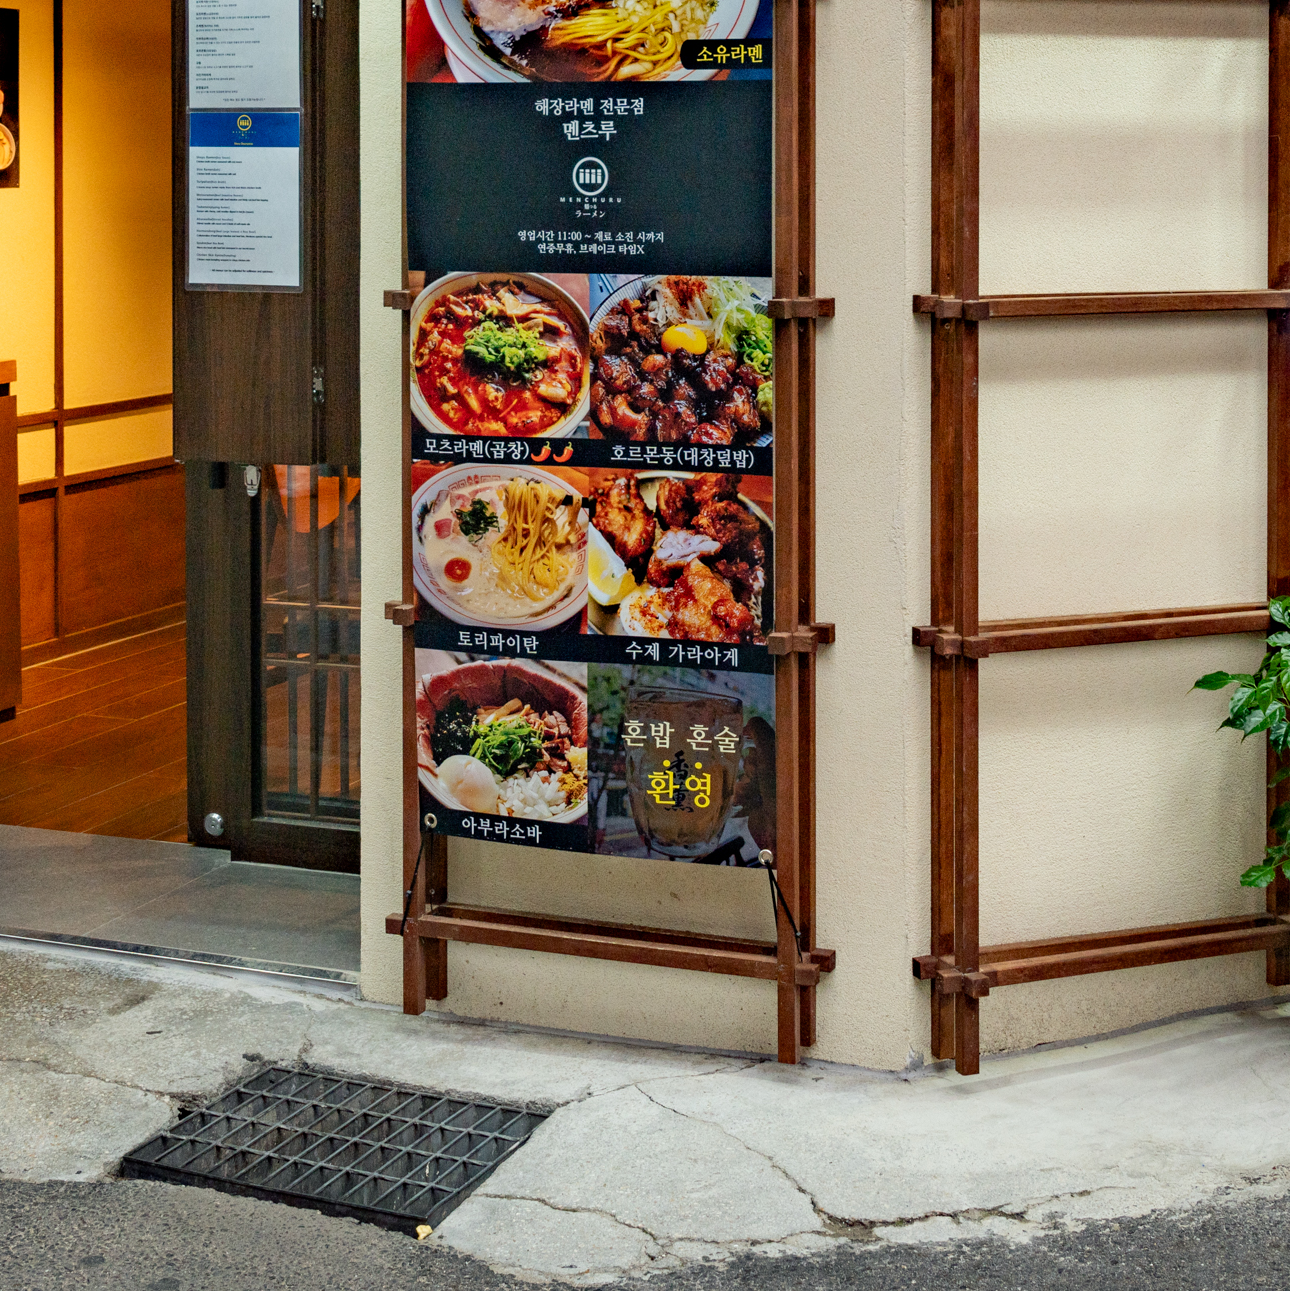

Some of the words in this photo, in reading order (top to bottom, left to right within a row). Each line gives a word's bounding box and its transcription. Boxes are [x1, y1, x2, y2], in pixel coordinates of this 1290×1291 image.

[696, 43, 763, 64] 소유라멘
[534, 98, 594, 116] 해장라멘
[598, 98, 645, 116] 전문점
[562, 120, 618, 141] 멘츠루
[575, 210, 606, 218] ラーメン
[518, 230, 554, 241] 영업시간
[558, 231, 582, 241] 11:00
[594, 231, 613, 242] 재료
[615, 231, 634, 242] 소진
[636, 231, 664, 243] 시까지
[579, 243, 616, 254] 브레이크
[618, 244, 645, 255] 타임X
[423, 436, 530, 462] 모츠라멘(곱창)
[610, 442, 755, 470] 호르몬동(대창덮밥)
[457, 630, 539, 654] 토리파이탄
[624, 640, 661, 662] 수제
[667, 642, 739, 667] 가라아게
[621, 719, 675, 750] 혼밥
[686, 723, 739, 754] 혼술
[646, 770, 712, 809] 환영
[461, 816, 543, 844] 아부라소바
